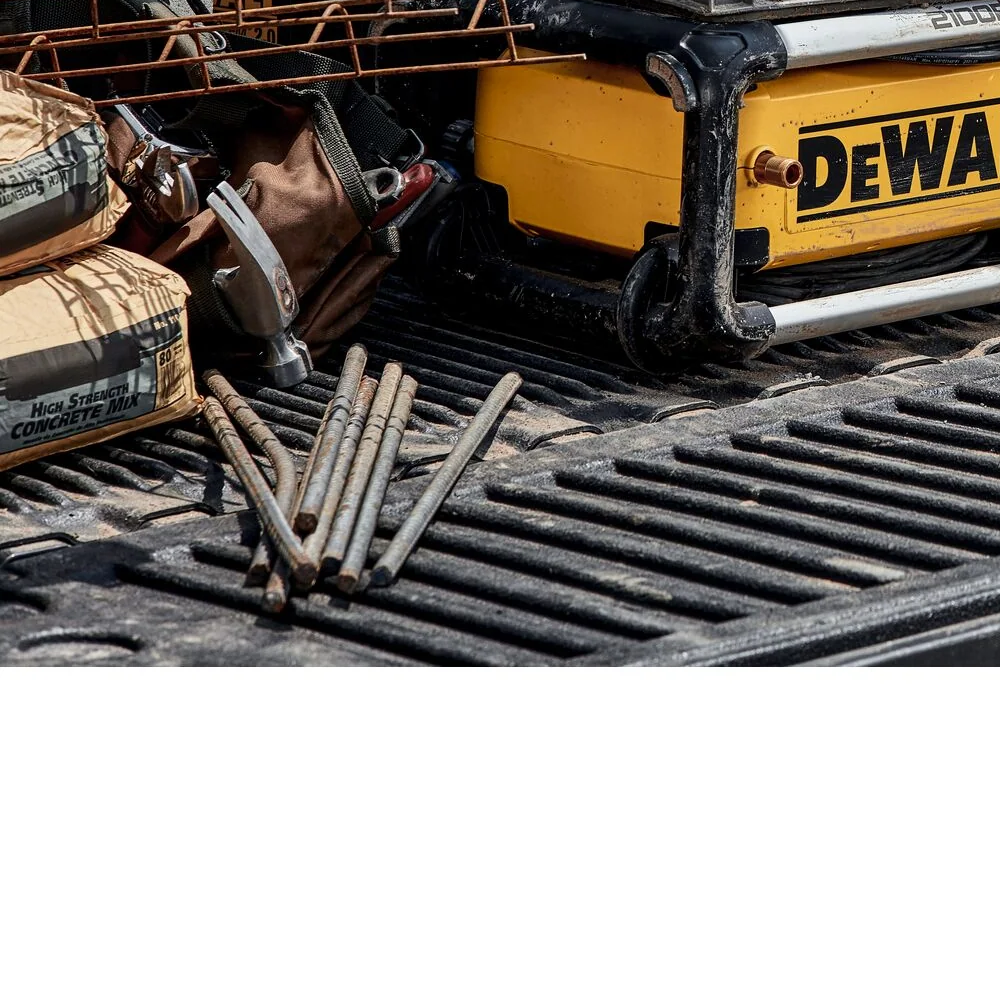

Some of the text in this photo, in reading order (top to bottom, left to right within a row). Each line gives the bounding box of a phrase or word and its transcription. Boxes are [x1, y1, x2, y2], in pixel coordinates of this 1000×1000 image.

[0, 180, 45, 208] STRENGT
[160, 348, 172, 367] 80
[11, 403, 104, 440] CONCRETE
[105, 392, 141, 416] MIX
[31, 383, 129, 419] HIGH STRENGTH
